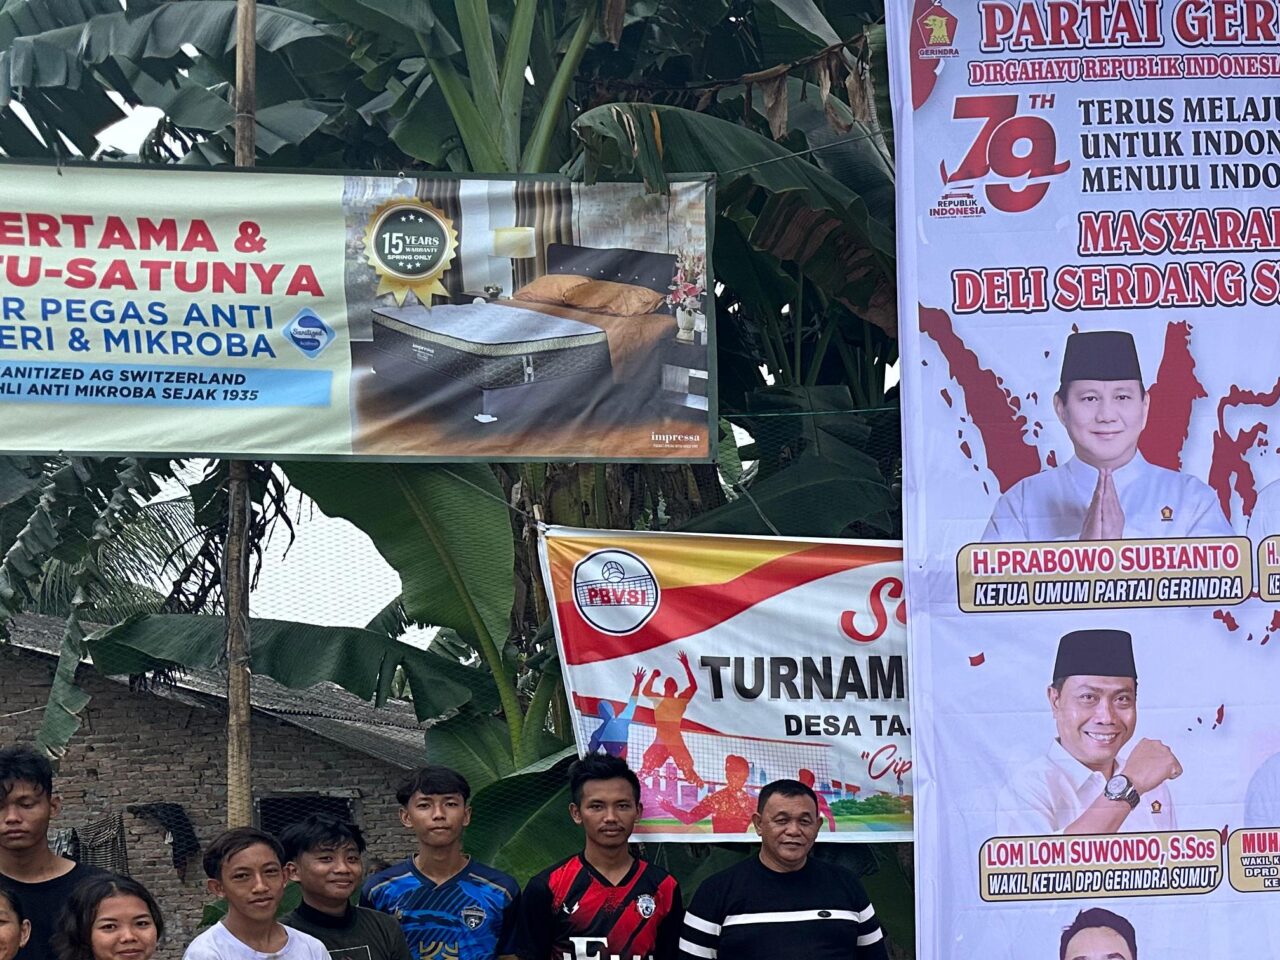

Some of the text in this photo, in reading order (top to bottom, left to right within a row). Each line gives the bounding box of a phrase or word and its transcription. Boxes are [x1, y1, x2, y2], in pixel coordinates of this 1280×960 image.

[980, 0, 1163, 49] PARTAI
[919, 48, 959, 56] GERINDRA
[970, 60, 1079, 84] DIRGAHAYU
[1082, 56, 1182, 79] REPUBLIK
[1029, 94, 1055, 109] TH
[1079, 98, 1174, 125] TERUS
[1080, 131, 1183, 158] UNTUK
[1081, 163, 1200, 192] MENUJU
[930, 207, 986, 216] INDONESIA
[937, 199, 977, 207] REPUBLIK
[0, 212, 267, 253] ERTAMA &
[382, 232, 440, 255] 15 YEARS
[0, 255, 325, 297] U-SATUNYA
[953, 269, 1047, 312] DELI
[1055, 261, 1245, 308] SERDANG
[3, 297, 273, 329] R PEGAS ANTI
[0, 325, 277, 358] ERI & MIKROBA
[0, 366, 246, 386] ANITIZED AG SWITZERLAND
[28, 384, 259, 401] ANTI MIKROBA SEJAK 1935
[651, 431, 700, 443] impressa
[973, 544, 1239, 574] H.PRABOWO SUBIANTO
[1267, 542, 1279, 565] H.
[588, 587, 646, 605] PBVSI
[975, 576, 1243, 605] KETUA UMUM PARTAI GERINDRA
[701, 656, 905, 699] TURNAM
[784, 714, 861, 736] DESA
[986, 836, 1215, 866] LOM LOM SUWONDO, S.Sos
[1242, 855, 1271, 866] WAKIL
[988, 866, 1217, 895] WAKIL KETUA DPD GERINDRA SUMUT
[1245, 866, 1278, 877] DPRD
